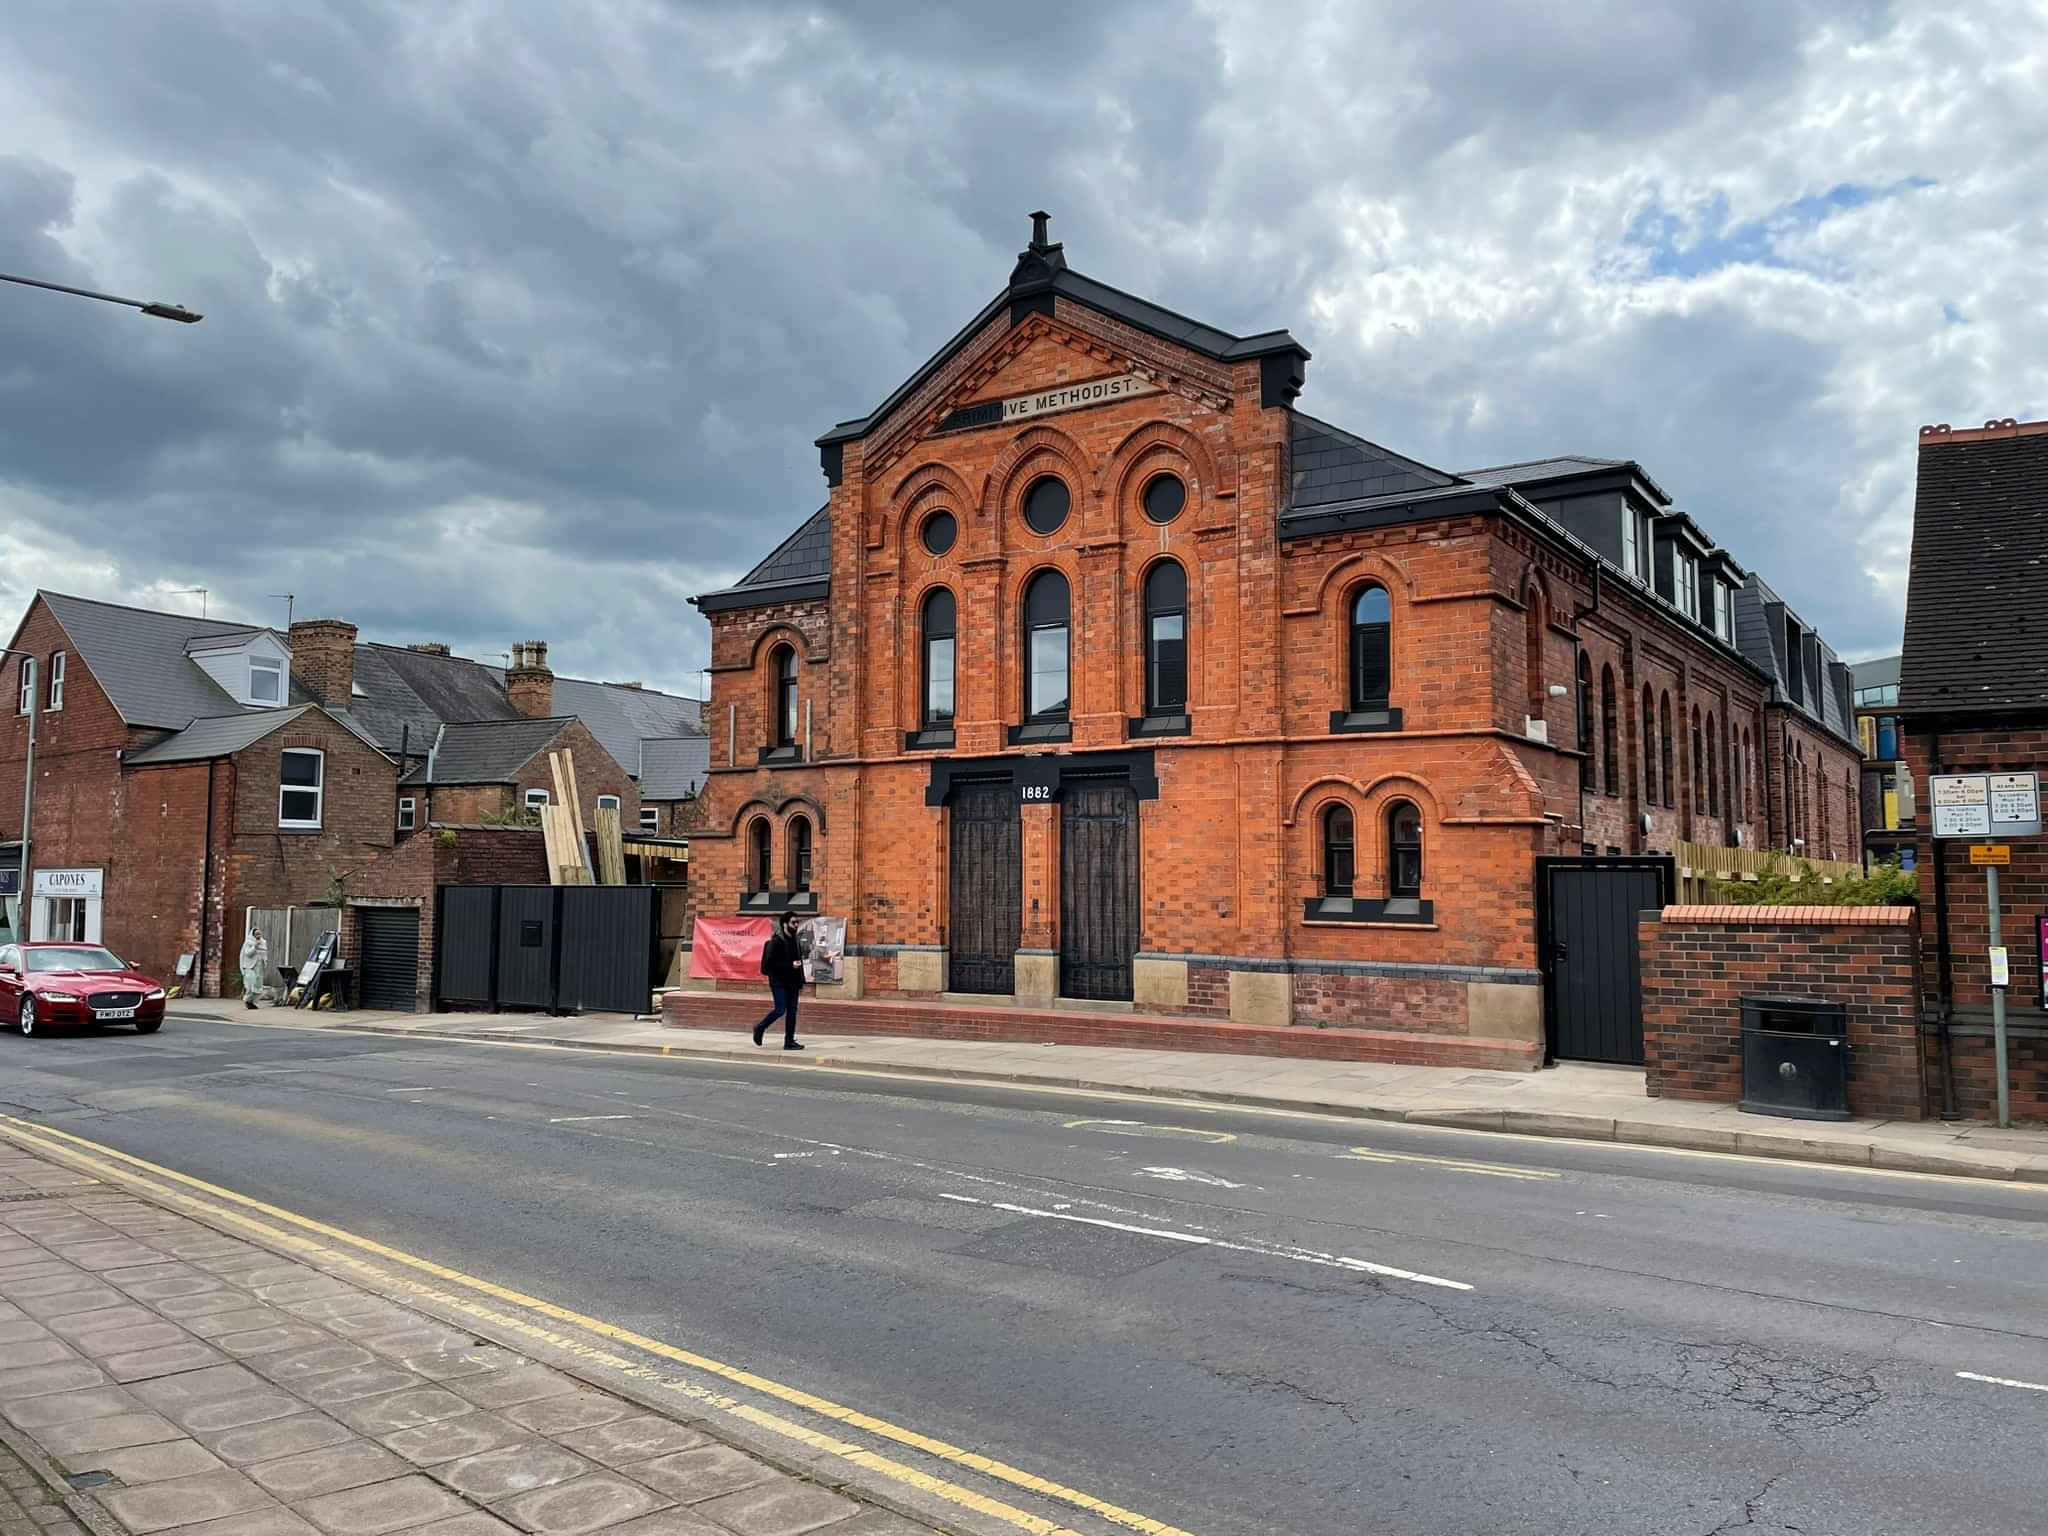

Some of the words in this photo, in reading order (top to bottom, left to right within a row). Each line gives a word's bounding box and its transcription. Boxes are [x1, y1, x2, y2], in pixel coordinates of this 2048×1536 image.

[1036, 378, 1139, 411] METHODIST.
[1022, 786, 1050, 799] 1882
[49, 873, 87, 886] CAPONES
